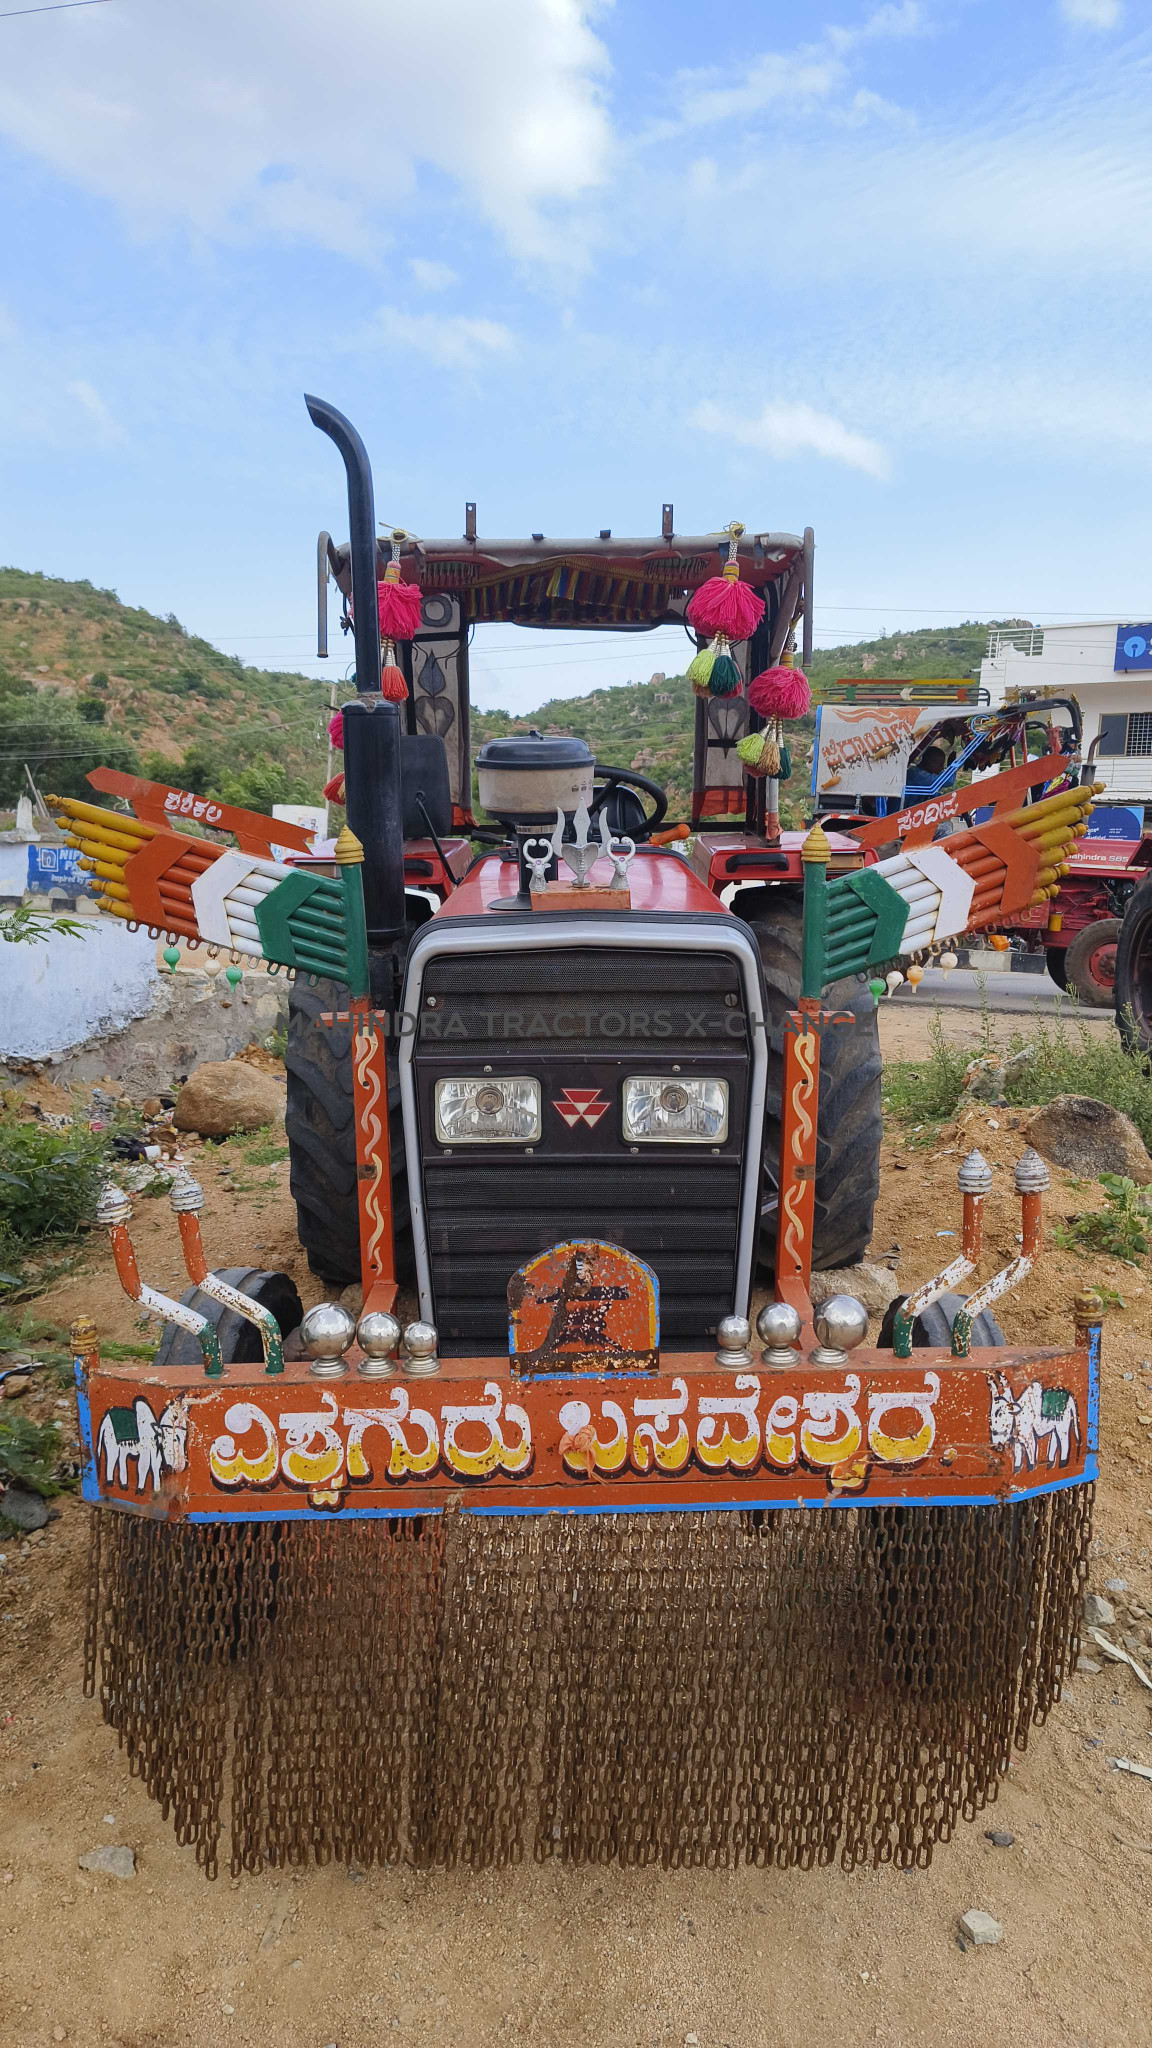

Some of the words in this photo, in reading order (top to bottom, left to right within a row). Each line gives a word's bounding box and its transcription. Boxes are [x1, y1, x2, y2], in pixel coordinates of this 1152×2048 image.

[59, 849, 84, 860] NIP
[210, 1381, 534, 1508] ವಿಶ್ವಗುರು
[558, 1371, 942, 1491] ಬಸವೇಶ್ವರ
